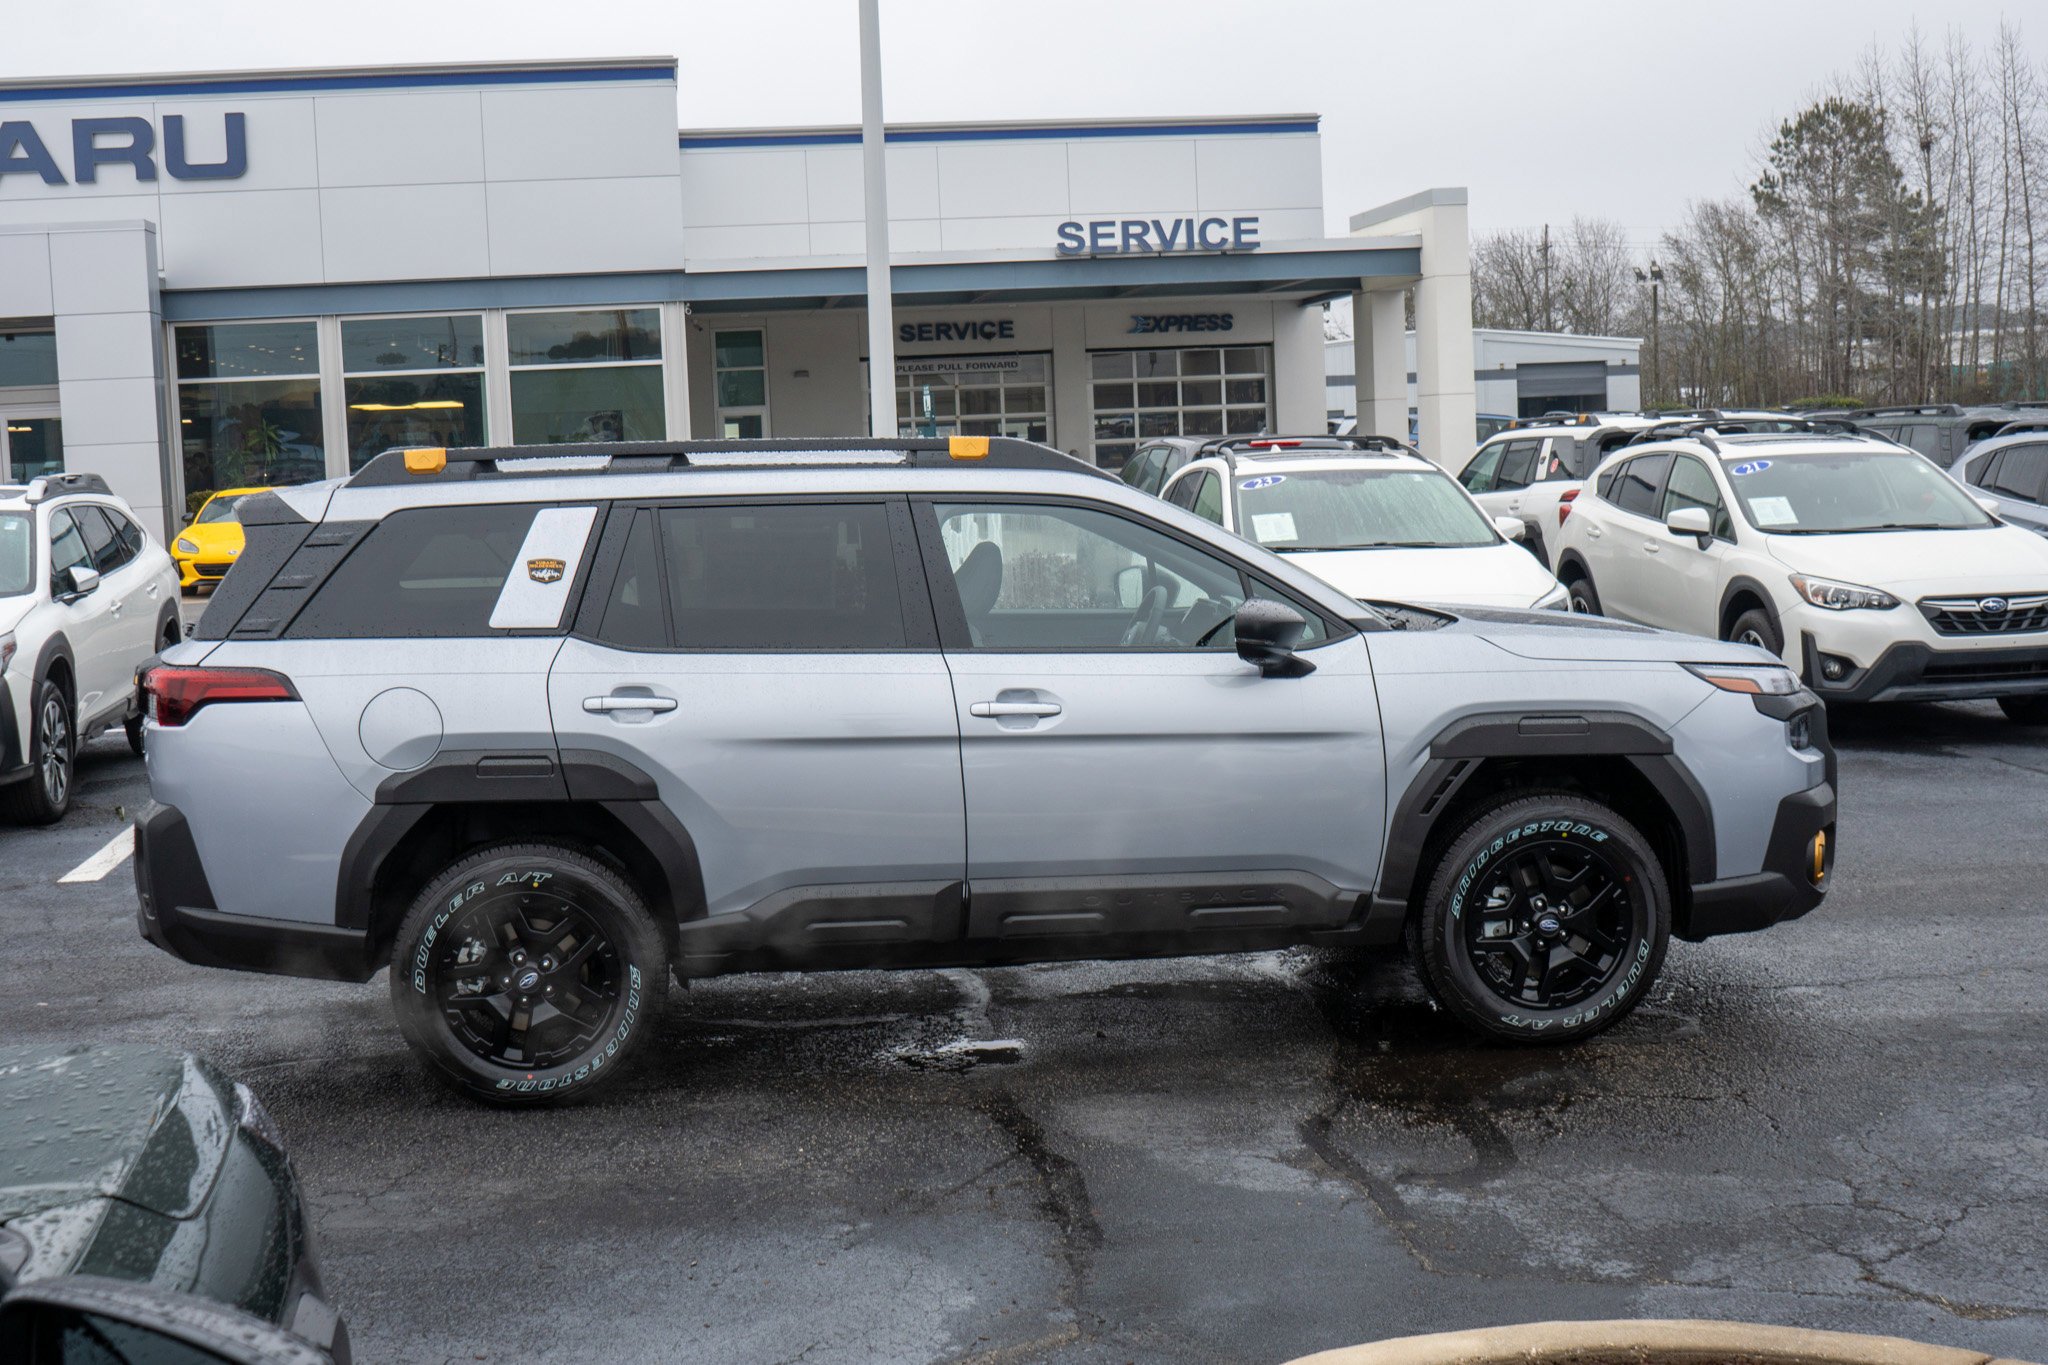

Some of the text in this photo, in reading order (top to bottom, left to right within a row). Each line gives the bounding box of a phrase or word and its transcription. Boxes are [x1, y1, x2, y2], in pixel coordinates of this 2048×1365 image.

[0, 112, 248, 185] ARU
[1057, 216, 1260, 255] SERVICE
[899, 320, 1015, 343] SERVICE
[1129, 313, 1234, 334] EXPRESS
[897, 360, 1018, 373] PLEASE PULL FORWARD
[1742, 461, 1761, 474] 21
[1450, 820, 1609, 920] BRIDGESTONE
[1082, 888, 1286, 907] OUTBACK
[414, 871, 552, 994] DUELER A/T
[1501, 938, 1650, 1030] DUELER A/T
[496, 963, 641, 1092] BRIDGESTONE
